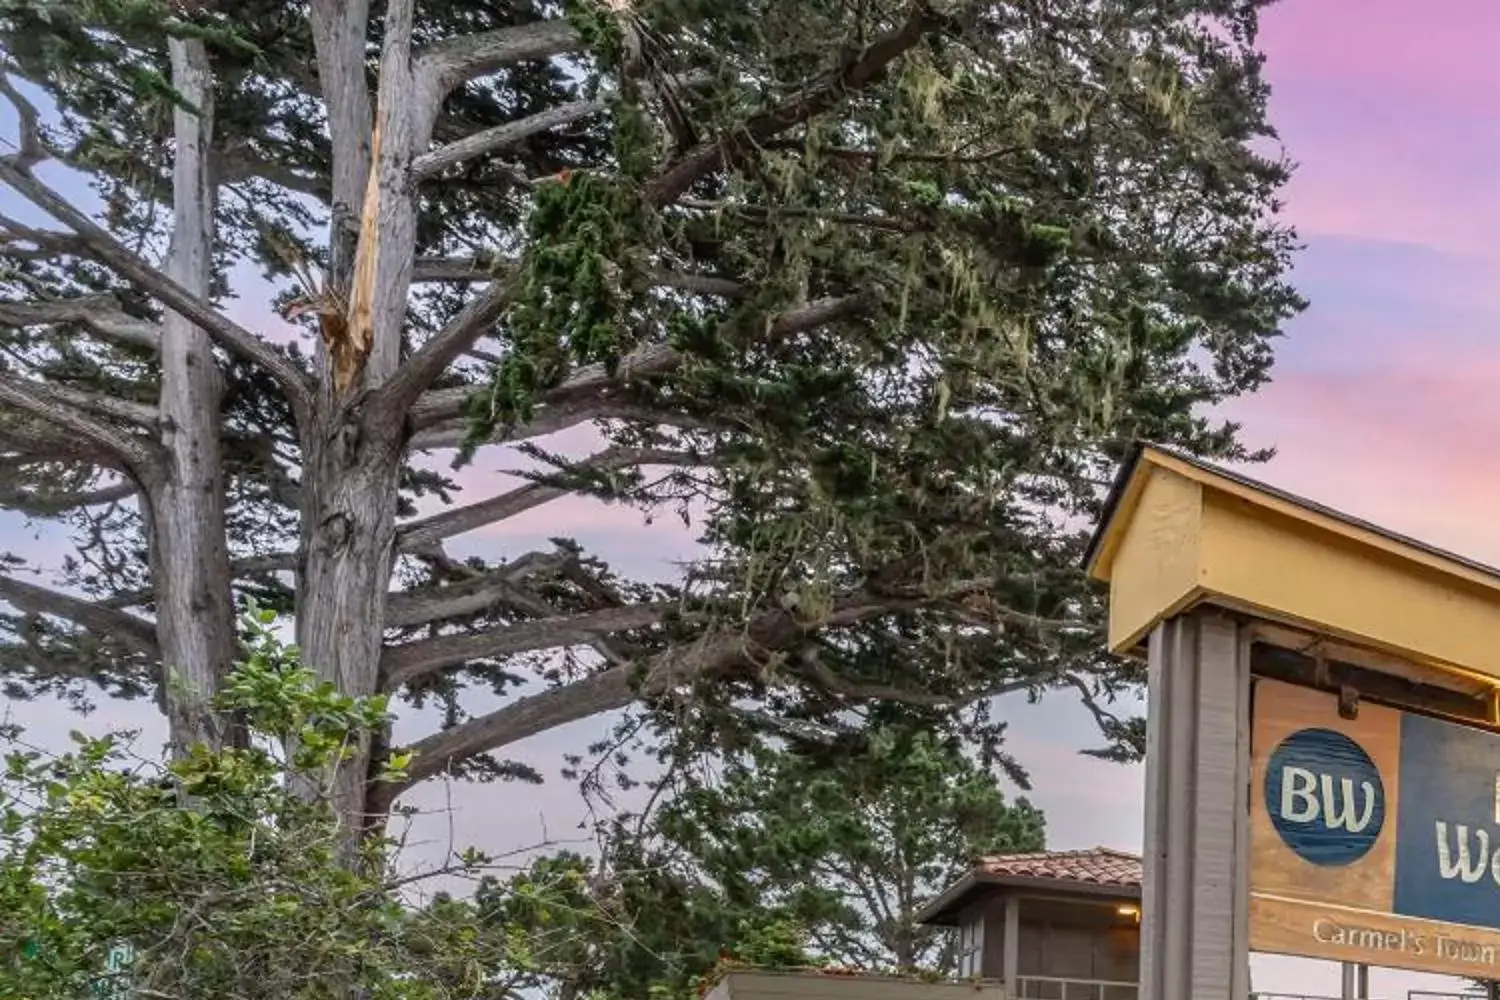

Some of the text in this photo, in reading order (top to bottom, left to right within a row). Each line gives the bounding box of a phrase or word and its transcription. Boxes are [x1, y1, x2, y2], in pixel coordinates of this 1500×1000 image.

[1280, 765, 1375, 834] BW
[1312, 917, 1425, 956] Carmel's
[1434, 933, 1495, 965] Town
